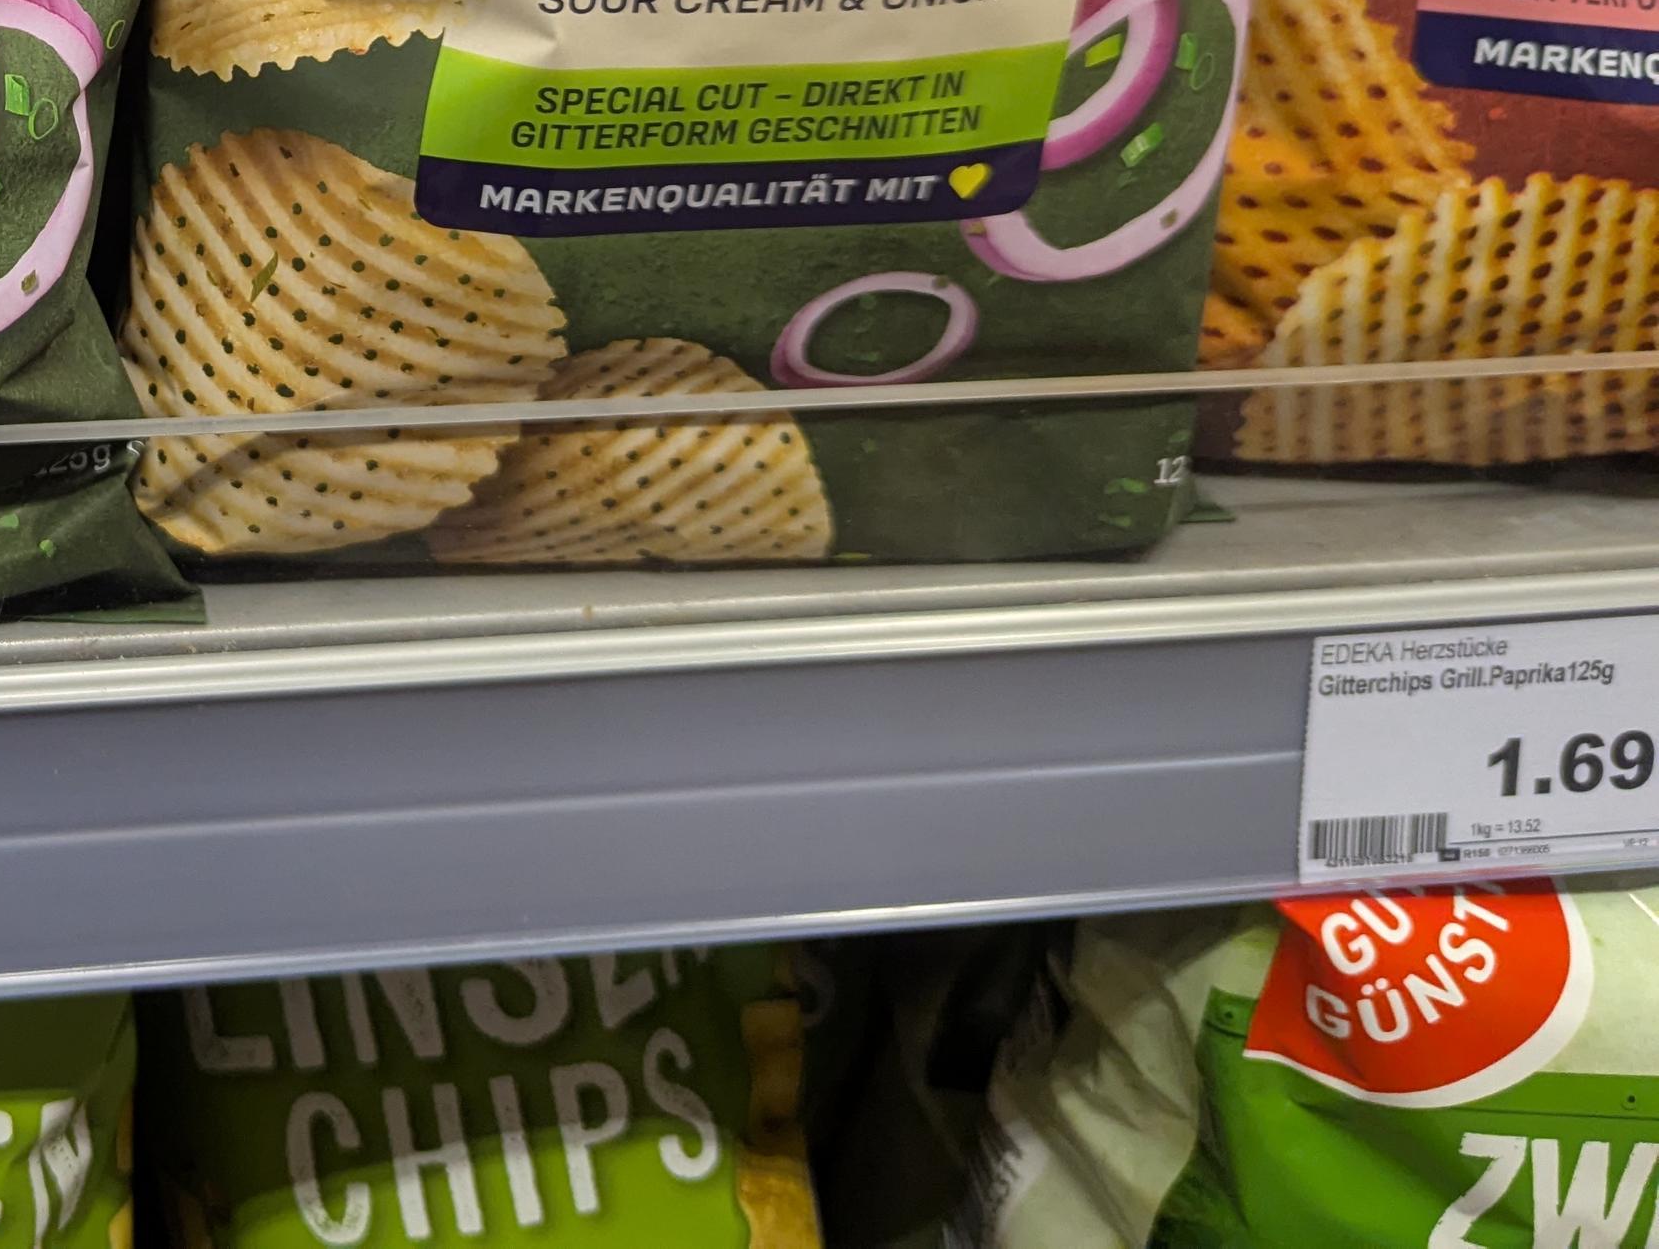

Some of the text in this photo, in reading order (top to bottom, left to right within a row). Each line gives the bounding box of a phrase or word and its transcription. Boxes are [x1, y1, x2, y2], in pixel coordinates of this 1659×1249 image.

[534, 84, 686, 116] SPECIAL
[697, 81, 769, 110] CUT
[801, 74, 926, 108] DIREKT
[930, 69, 967, 99] IN
[510, 105, 984, 150] GITTERFORM GESCHNITTEN
[479, 173, 940, 215] MARKENQUALITÄT MIT
[1320, 637, 1509, 665] EDEKA Herzstücke
[1318, 659, 1615, 697] Gitterchips Grill.Paprika125g
[1487, 729, 1655, 797] 1.69
[1471, 823, 1491, 838] 1kg
[1306, 888, 1508, 1042] GÜNST
[286, 1027, 721, 1246] CHIPS
